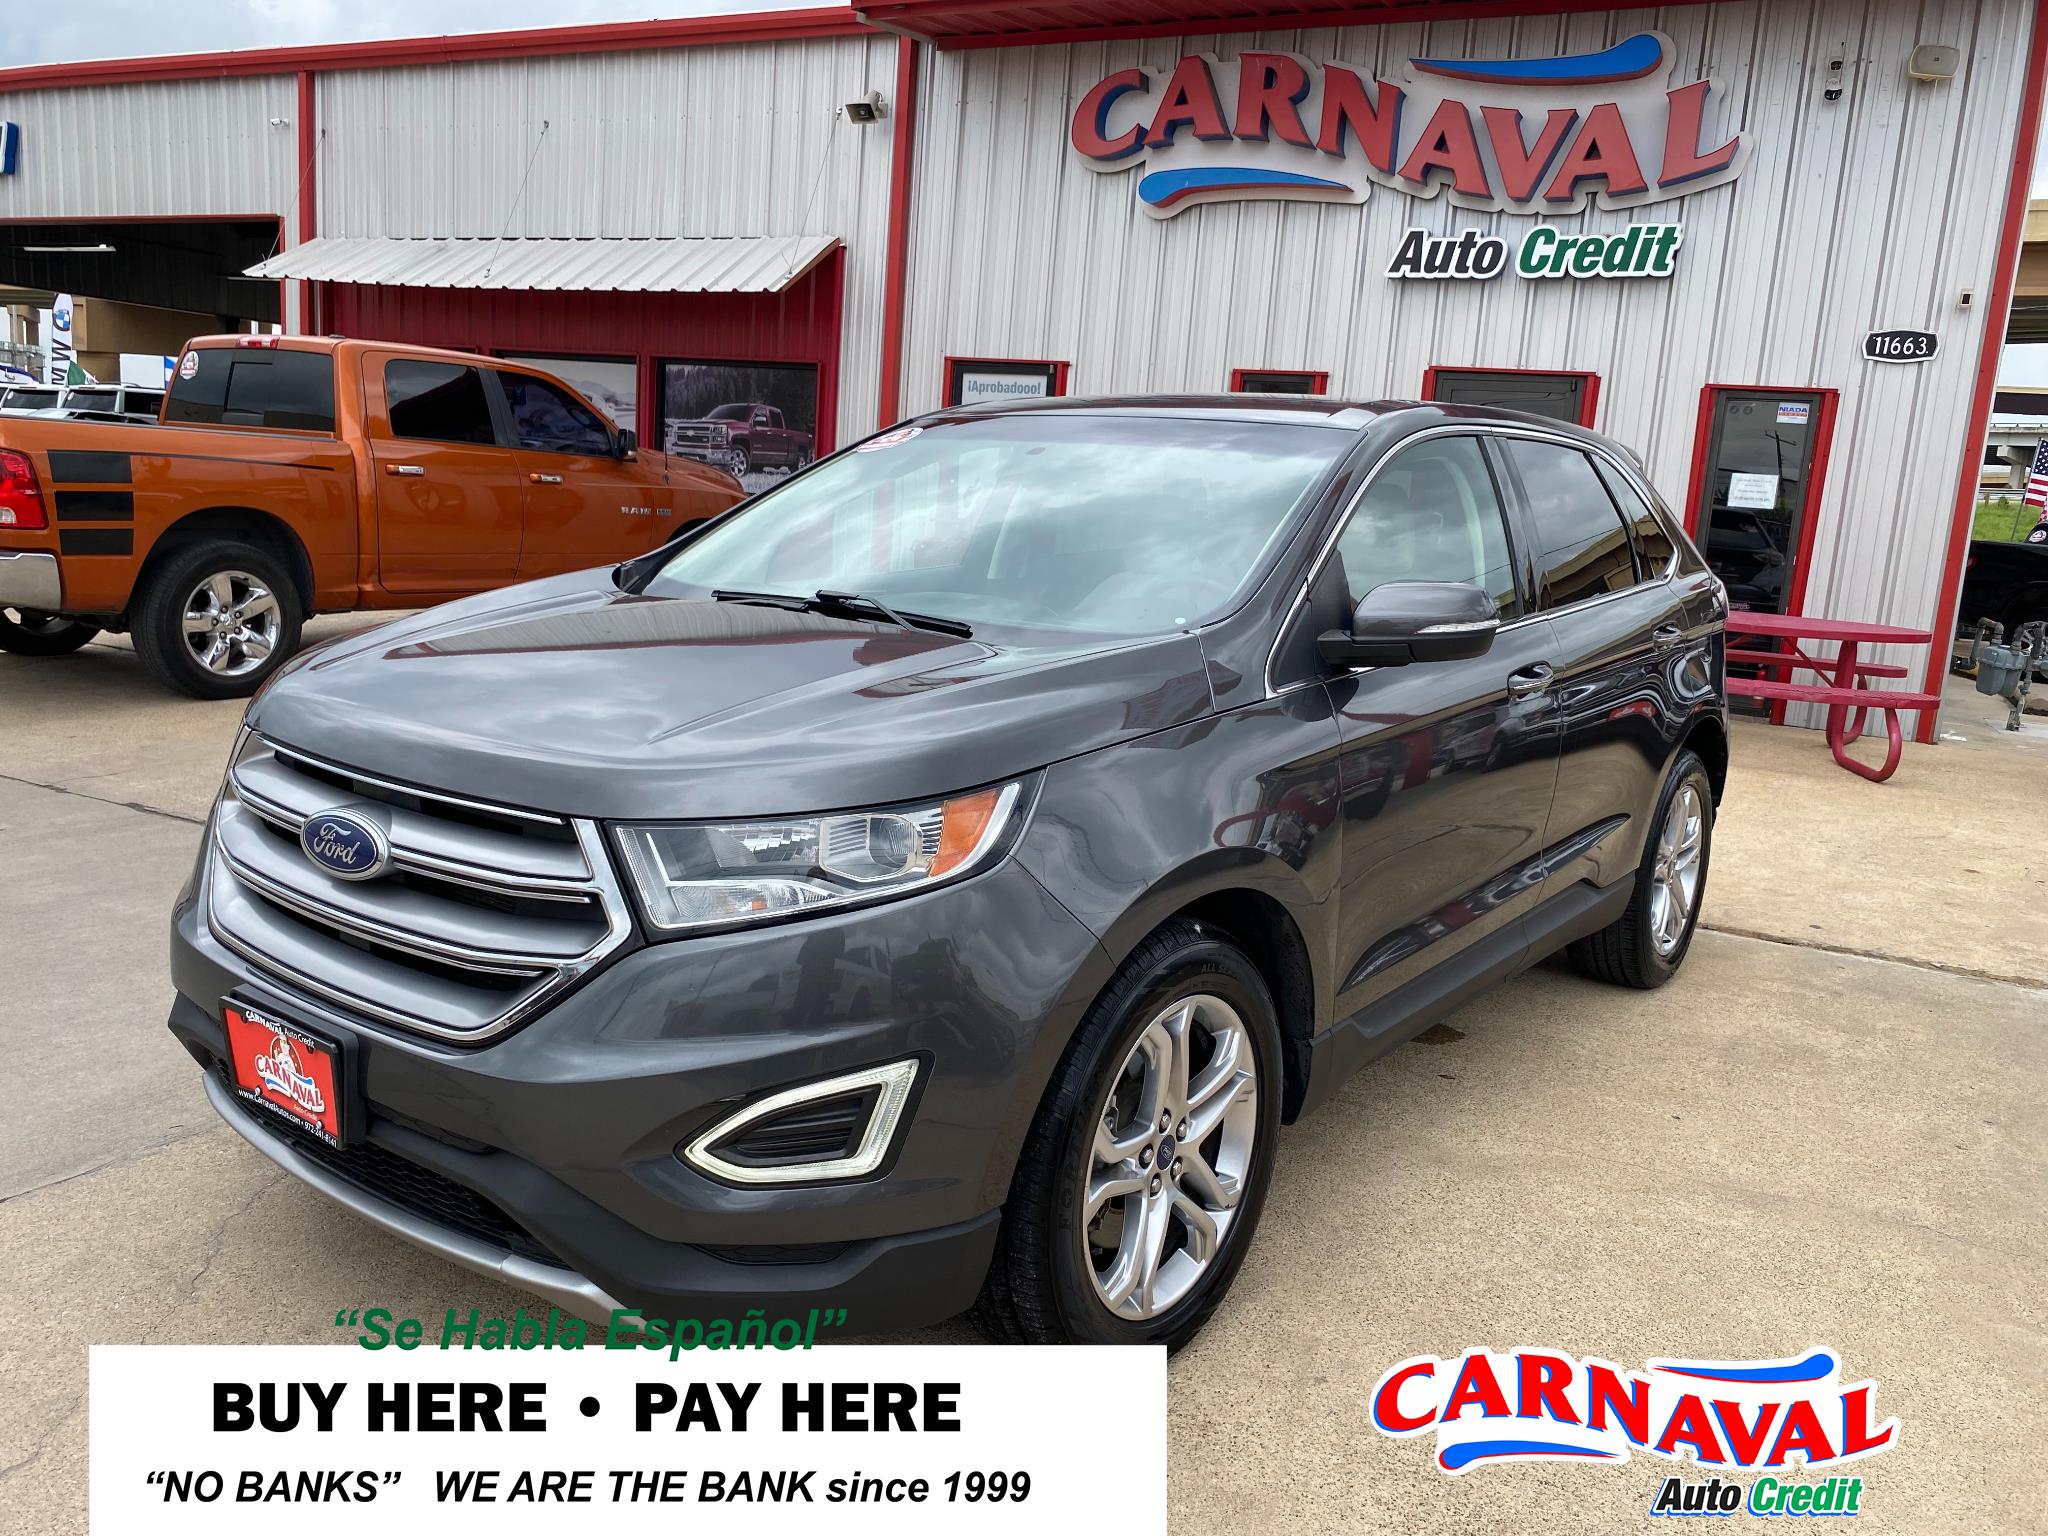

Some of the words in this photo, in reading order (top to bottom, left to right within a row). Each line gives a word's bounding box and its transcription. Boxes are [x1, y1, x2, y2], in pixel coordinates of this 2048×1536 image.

[1071, 52, 1740, 201] CARNAVAL
[1390, 229, 1504, 278] Auto
[1517, 225, 1680, 277] Credit
[1873, 336, 1927, 355] 11663
[968, 380, 1041, 395] ¡Aprobadooo!
[313, 823, 361, 865] Ford
[245, 1010, 283, 1035] CARNAVAL
[255, 1056, 323, 1107] CARNAVAL
